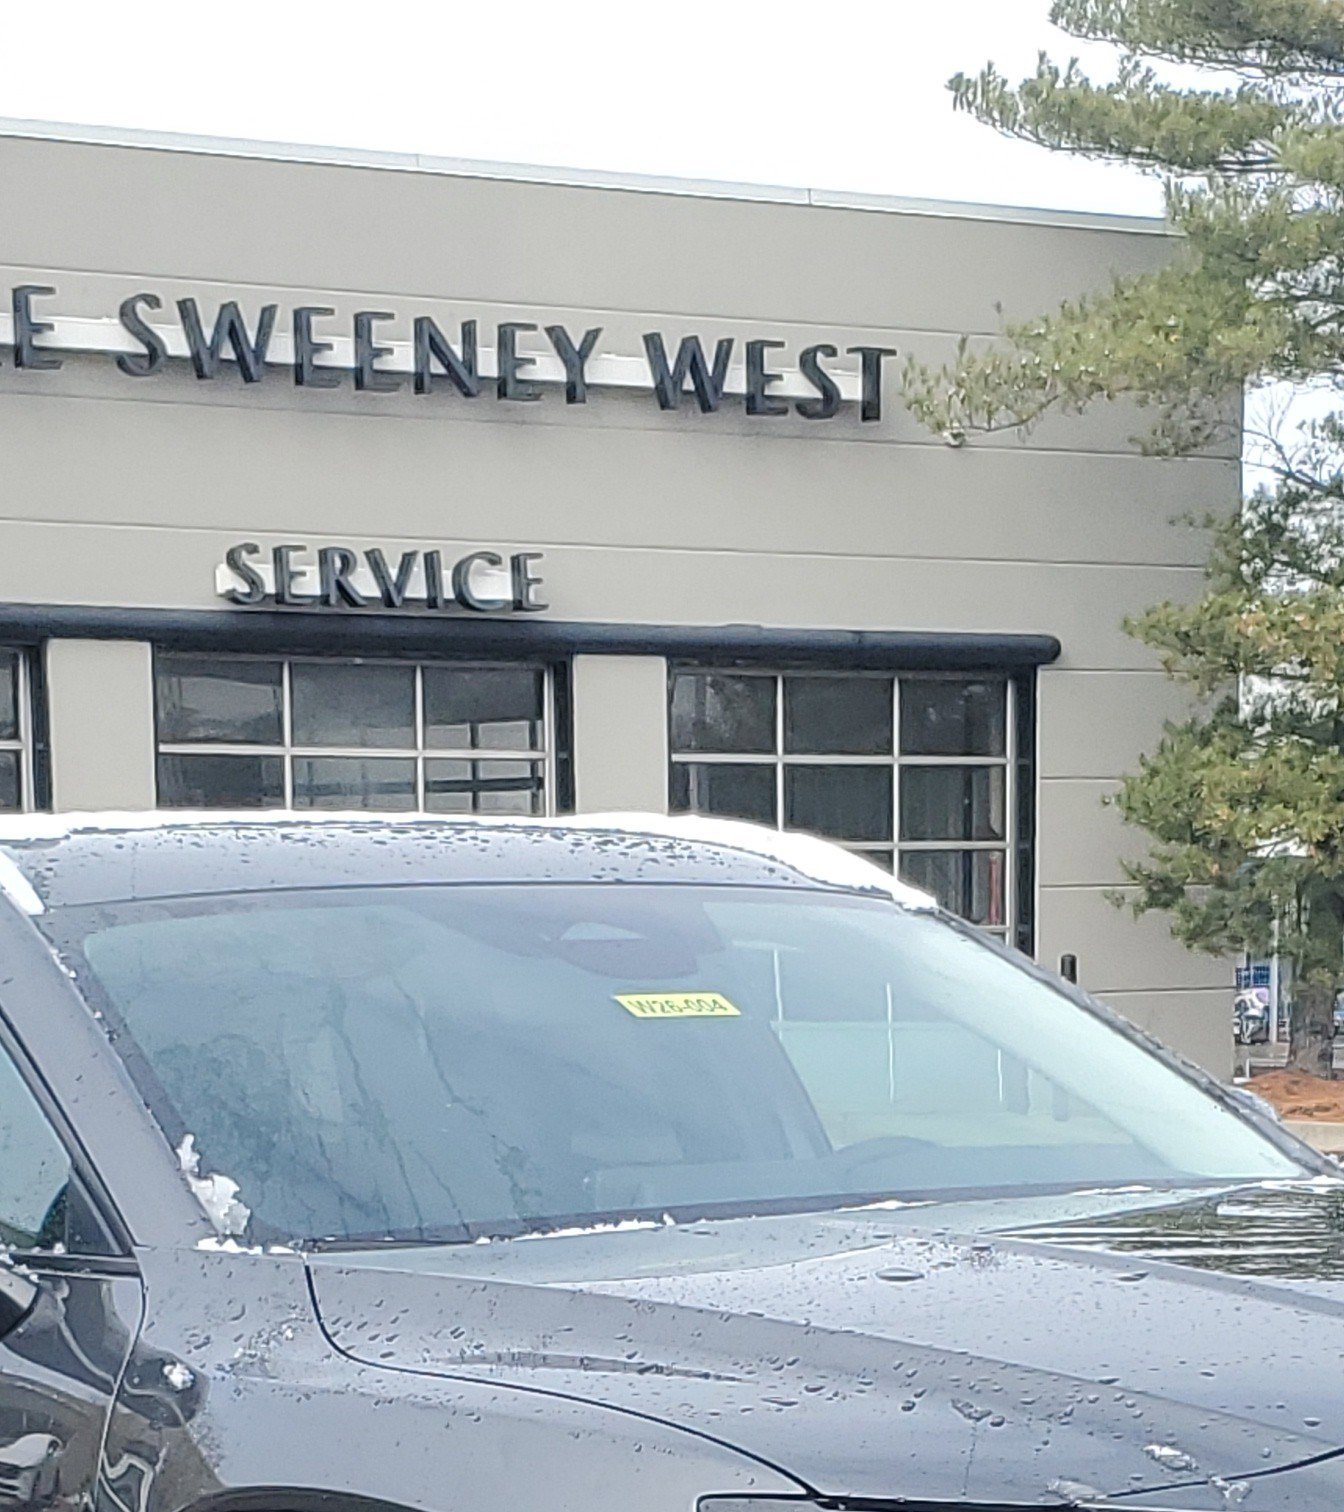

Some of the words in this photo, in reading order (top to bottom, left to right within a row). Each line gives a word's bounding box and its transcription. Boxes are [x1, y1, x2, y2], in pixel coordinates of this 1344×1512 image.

[117, 292, 603, 404] SWEENEY
[642, 331, 897, 422] WEST
[224, 542, 549, 612] SERVICE
